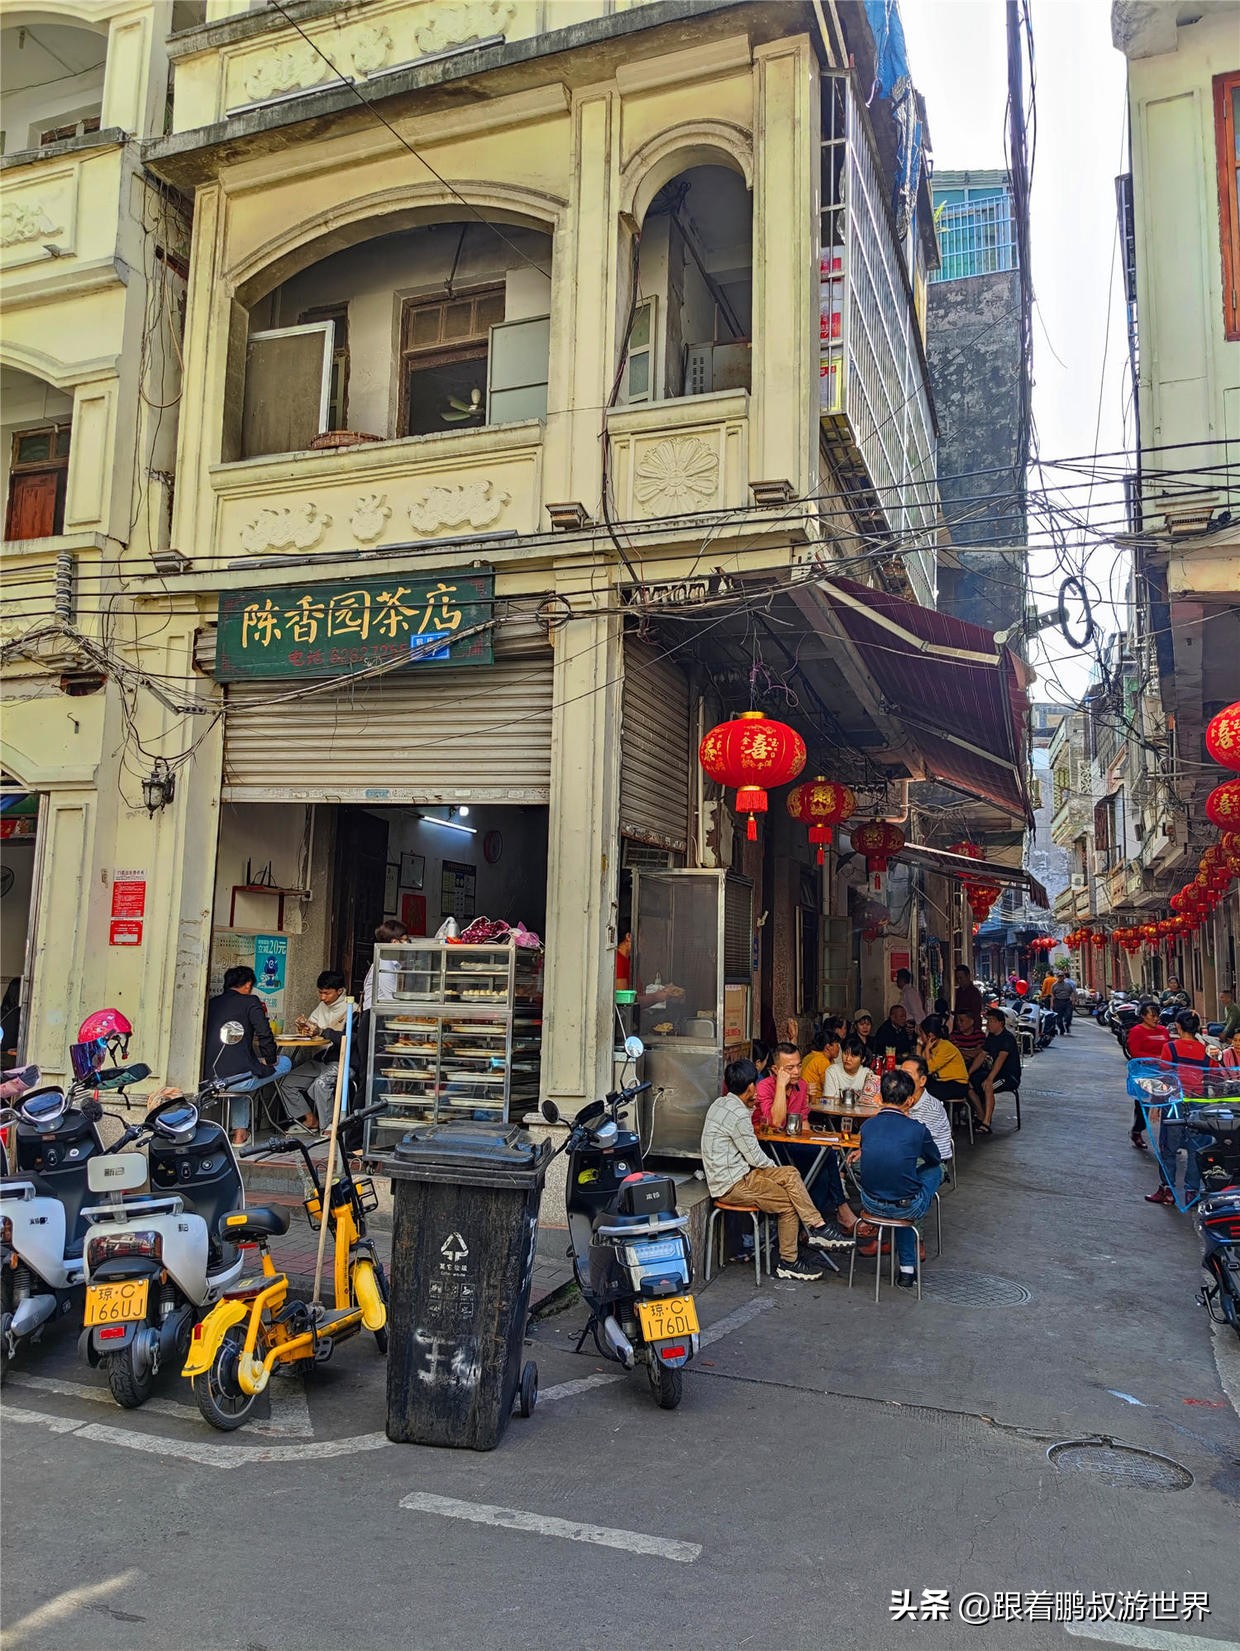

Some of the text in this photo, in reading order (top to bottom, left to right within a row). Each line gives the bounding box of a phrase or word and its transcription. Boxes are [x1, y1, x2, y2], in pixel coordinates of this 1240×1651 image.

[241, 582, 462, 648] 陈香园茶店
[288, 649, 323, 666] 电话
[744, 733, 773, 759] 喜
[91, 1298, 143, 1322] 166UJ
[648, 1315, 696, 1338] 176DL
